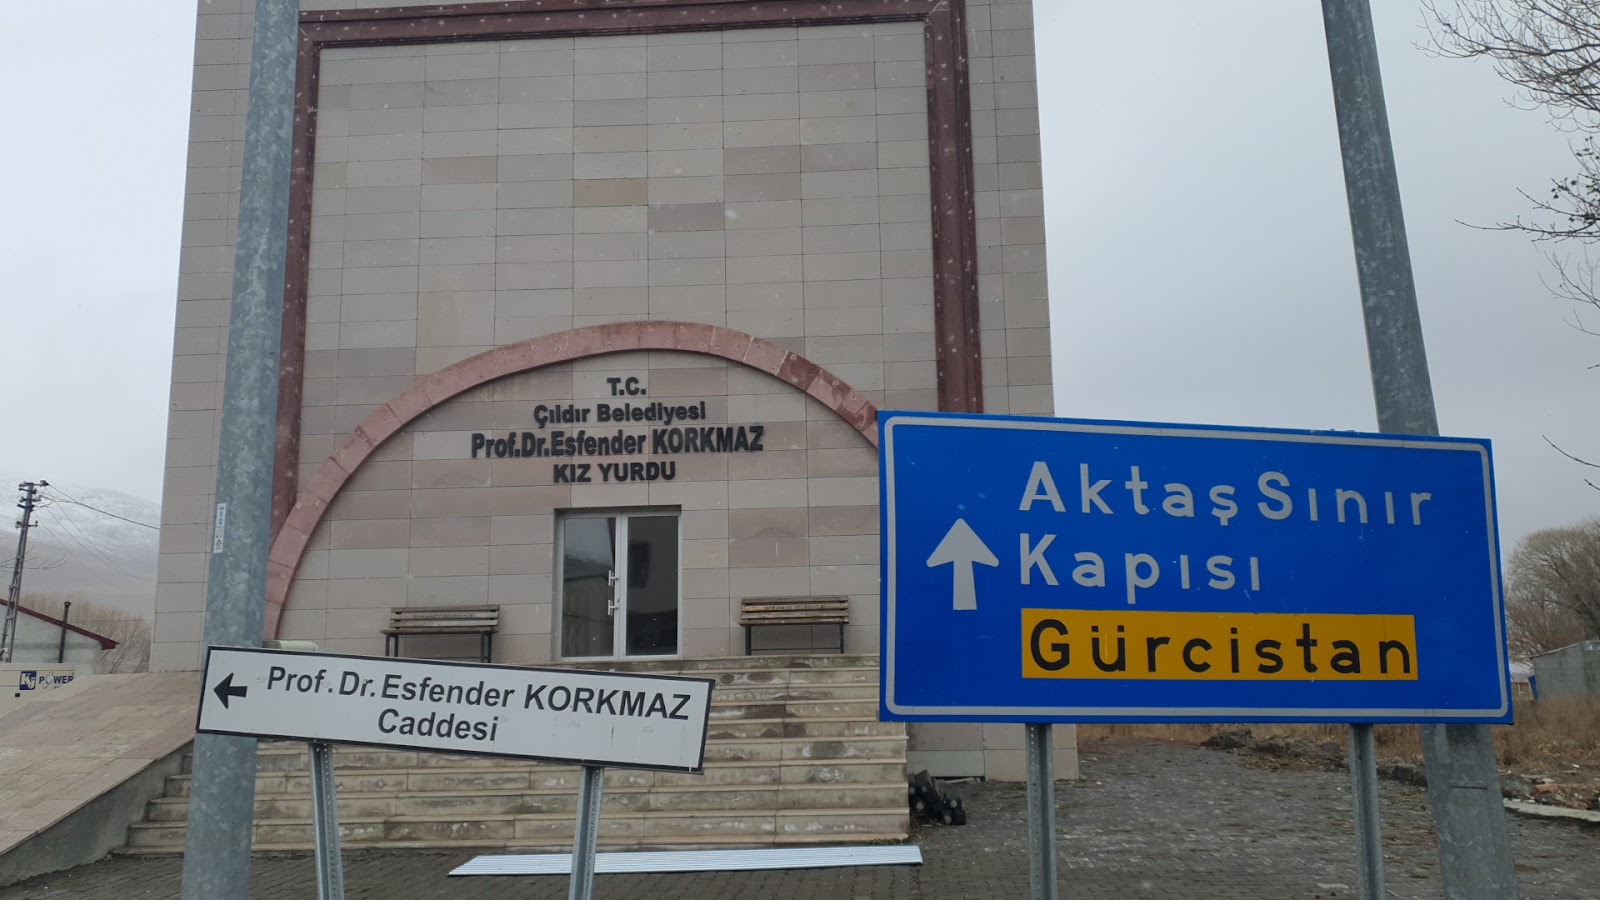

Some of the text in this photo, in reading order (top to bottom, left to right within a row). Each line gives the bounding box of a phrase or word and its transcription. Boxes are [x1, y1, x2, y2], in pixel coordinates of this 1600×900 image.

[606, 376, 647, 396] T.C.
[533, 401, 706, 429] Çıldır Belediyesi
[652, 425, 764, 455] KORKMAZ
[553, 461, 676, 484] KIZ YURDU
[1019, 461, 1432, 526] Aktaş Sınır
[1019, 532, 1261, 605] Kapısı
[1030, 617, 1412, 676] Gürcistan
[523, 684, 692, 721] KORKMAZ
[378, 708, 499, 742] Caddesi
